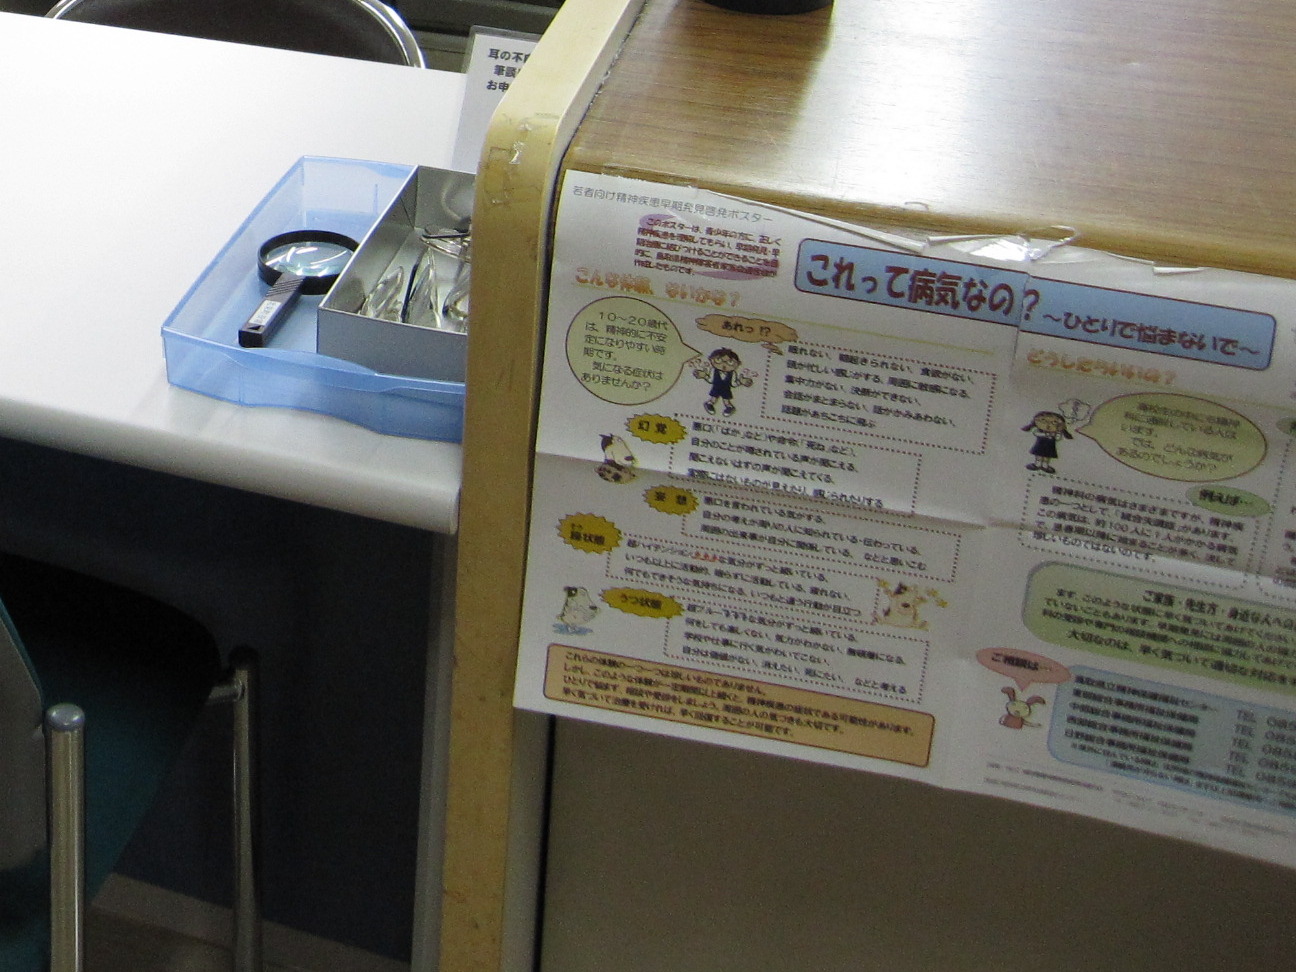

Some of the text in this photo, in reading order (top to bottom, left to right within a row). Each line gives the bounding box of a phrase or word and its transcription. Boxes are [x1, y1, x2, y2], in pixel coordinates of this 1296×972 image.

[494, 65, 521, 78] 筆談
[806, 254, 1039, 321] これって病気なの？
